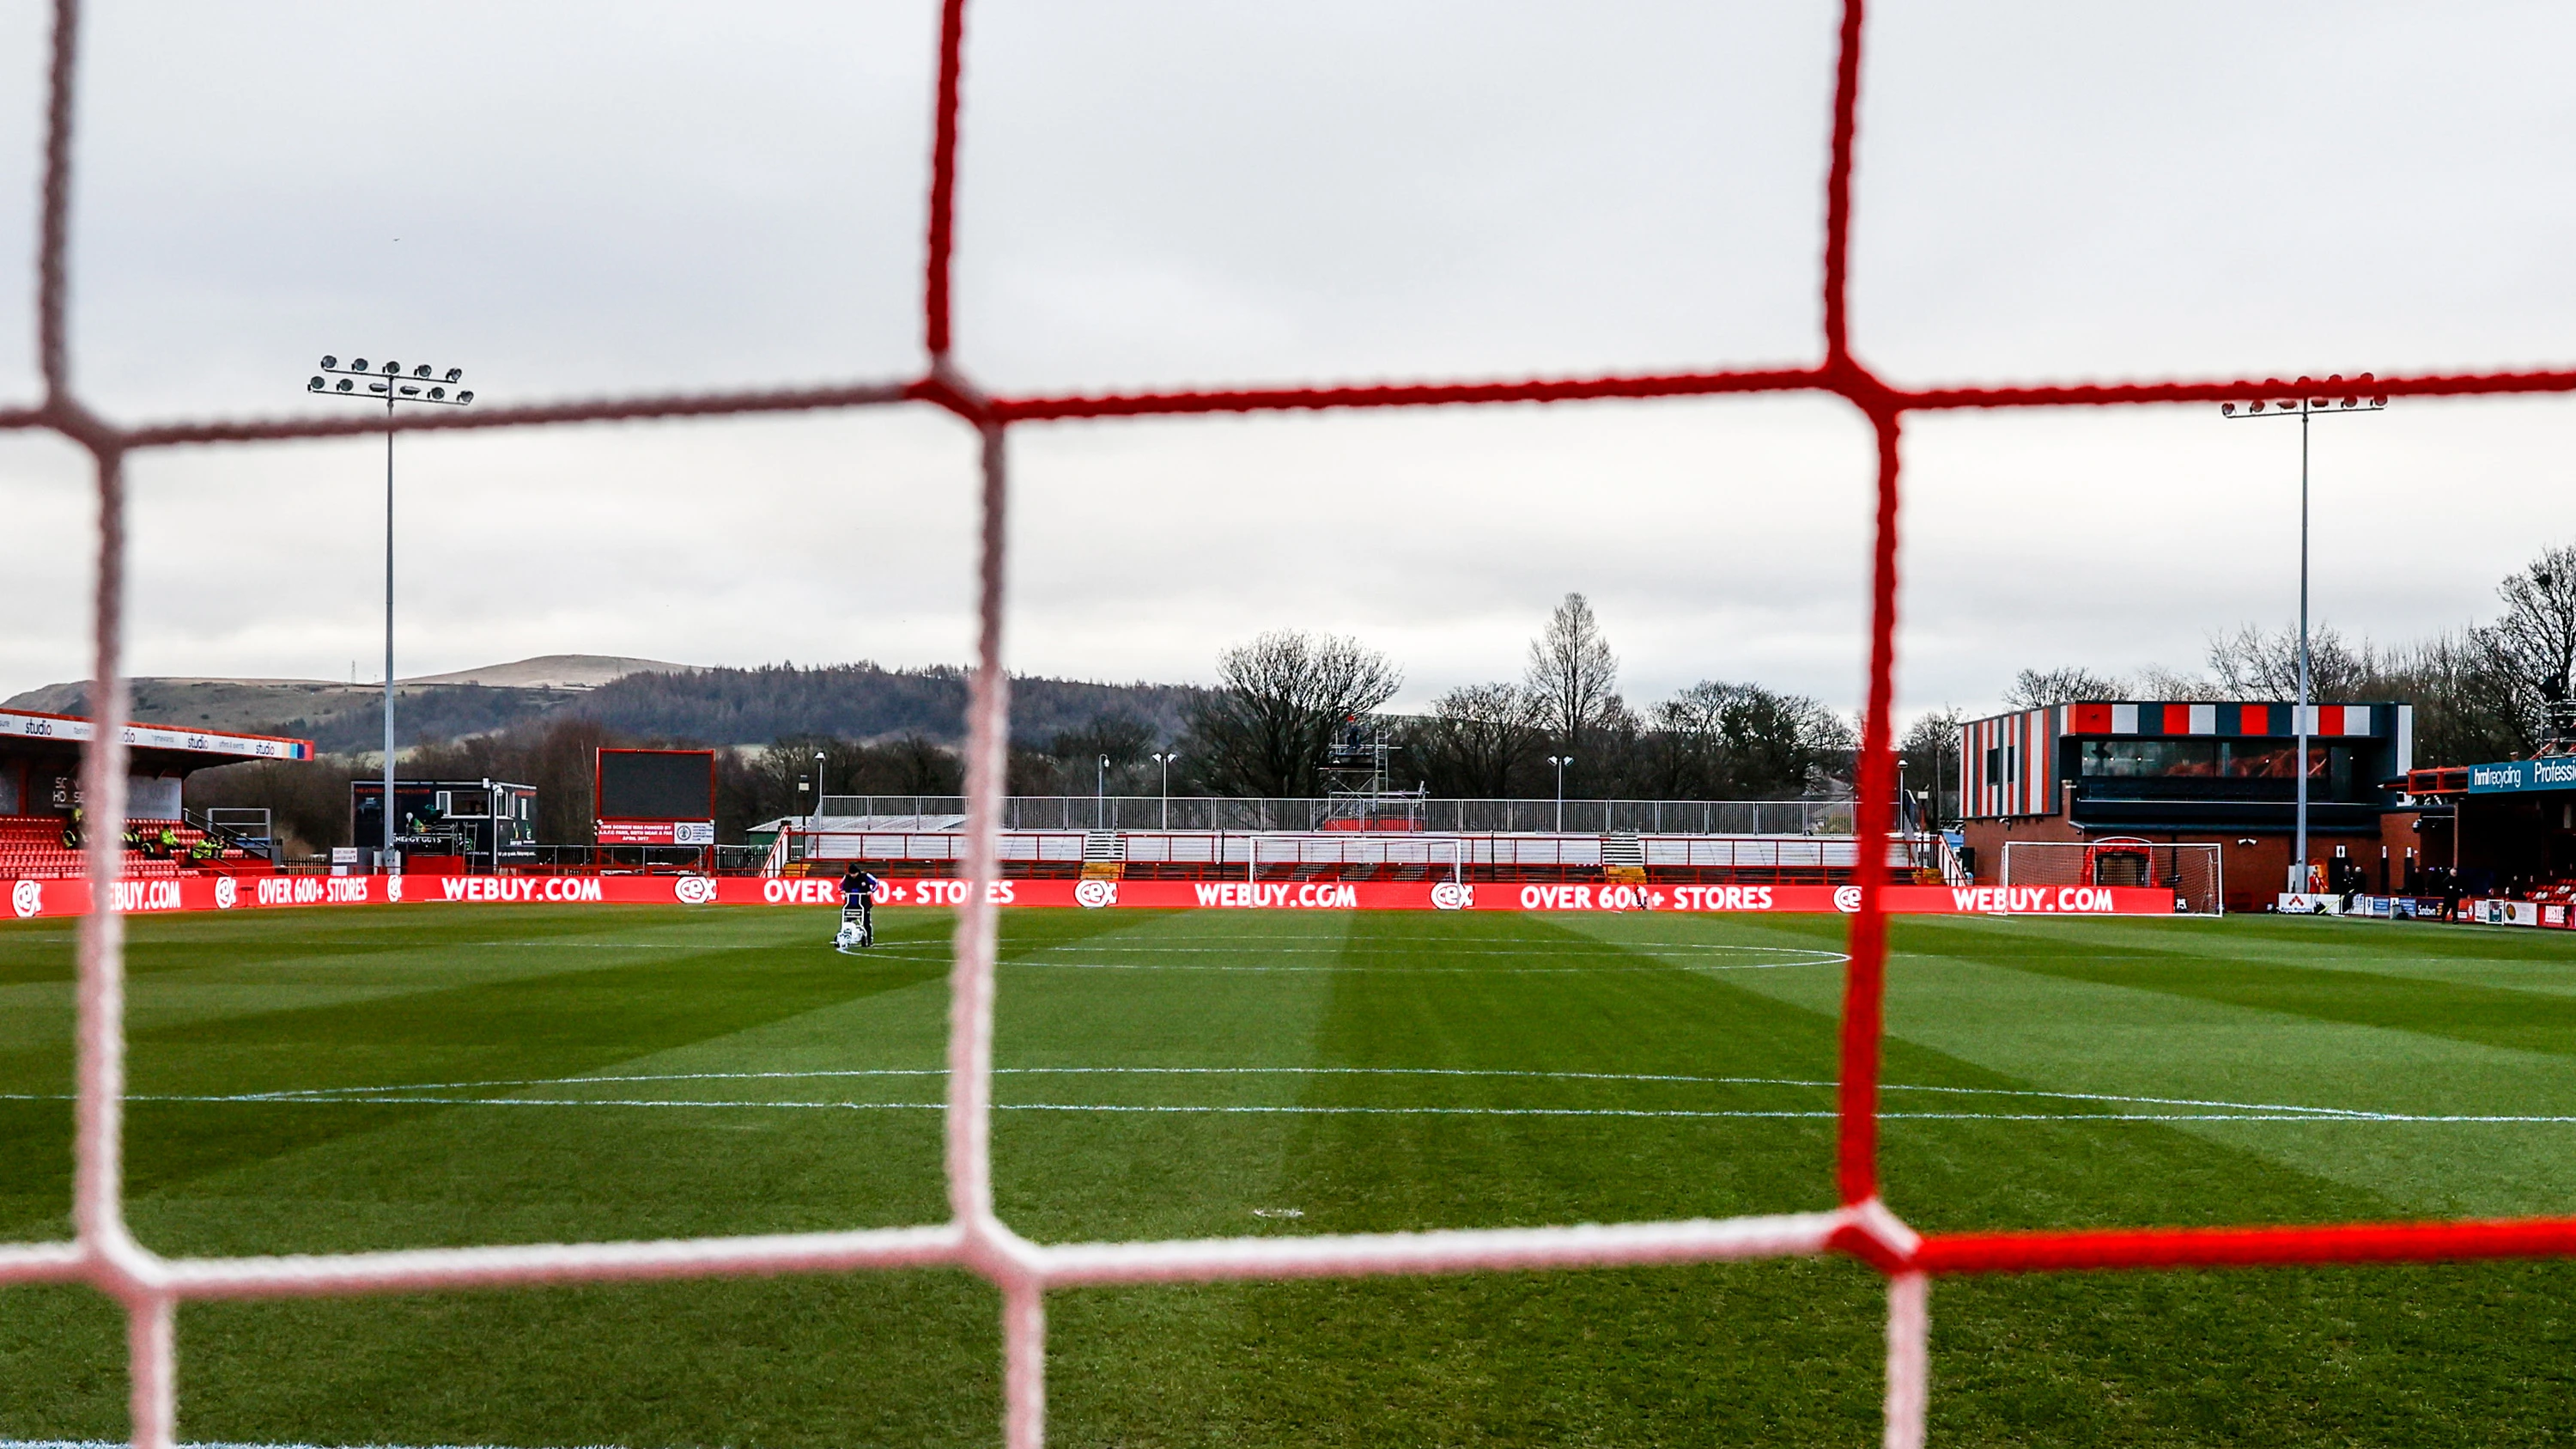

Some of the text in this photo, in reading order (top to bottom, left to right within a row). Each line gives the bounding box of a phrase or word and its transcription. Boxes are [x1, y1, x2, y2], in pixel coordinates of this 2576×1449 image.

[25, 718, 52, 736] studio
[187, 734, 209, 750] studio
[256, 741, 275, 756] studio
[2534, 759, 2576, 783] Professi
[89, 880, 181, 910] EBUY.COM
[258, 877, 368, 904] OVER 600+ STORES
[441, 878, 602, 900] WEBUY.COM
[763, 880, 835, 902] OVER
[1194, 883, 1357, 907] WEBUY.COM
[1521, 886, 1592, 909] OVER
[1674, 886, 1772, 910] STORES
[1952, 888, 2113, 911] WEBUY.COM
